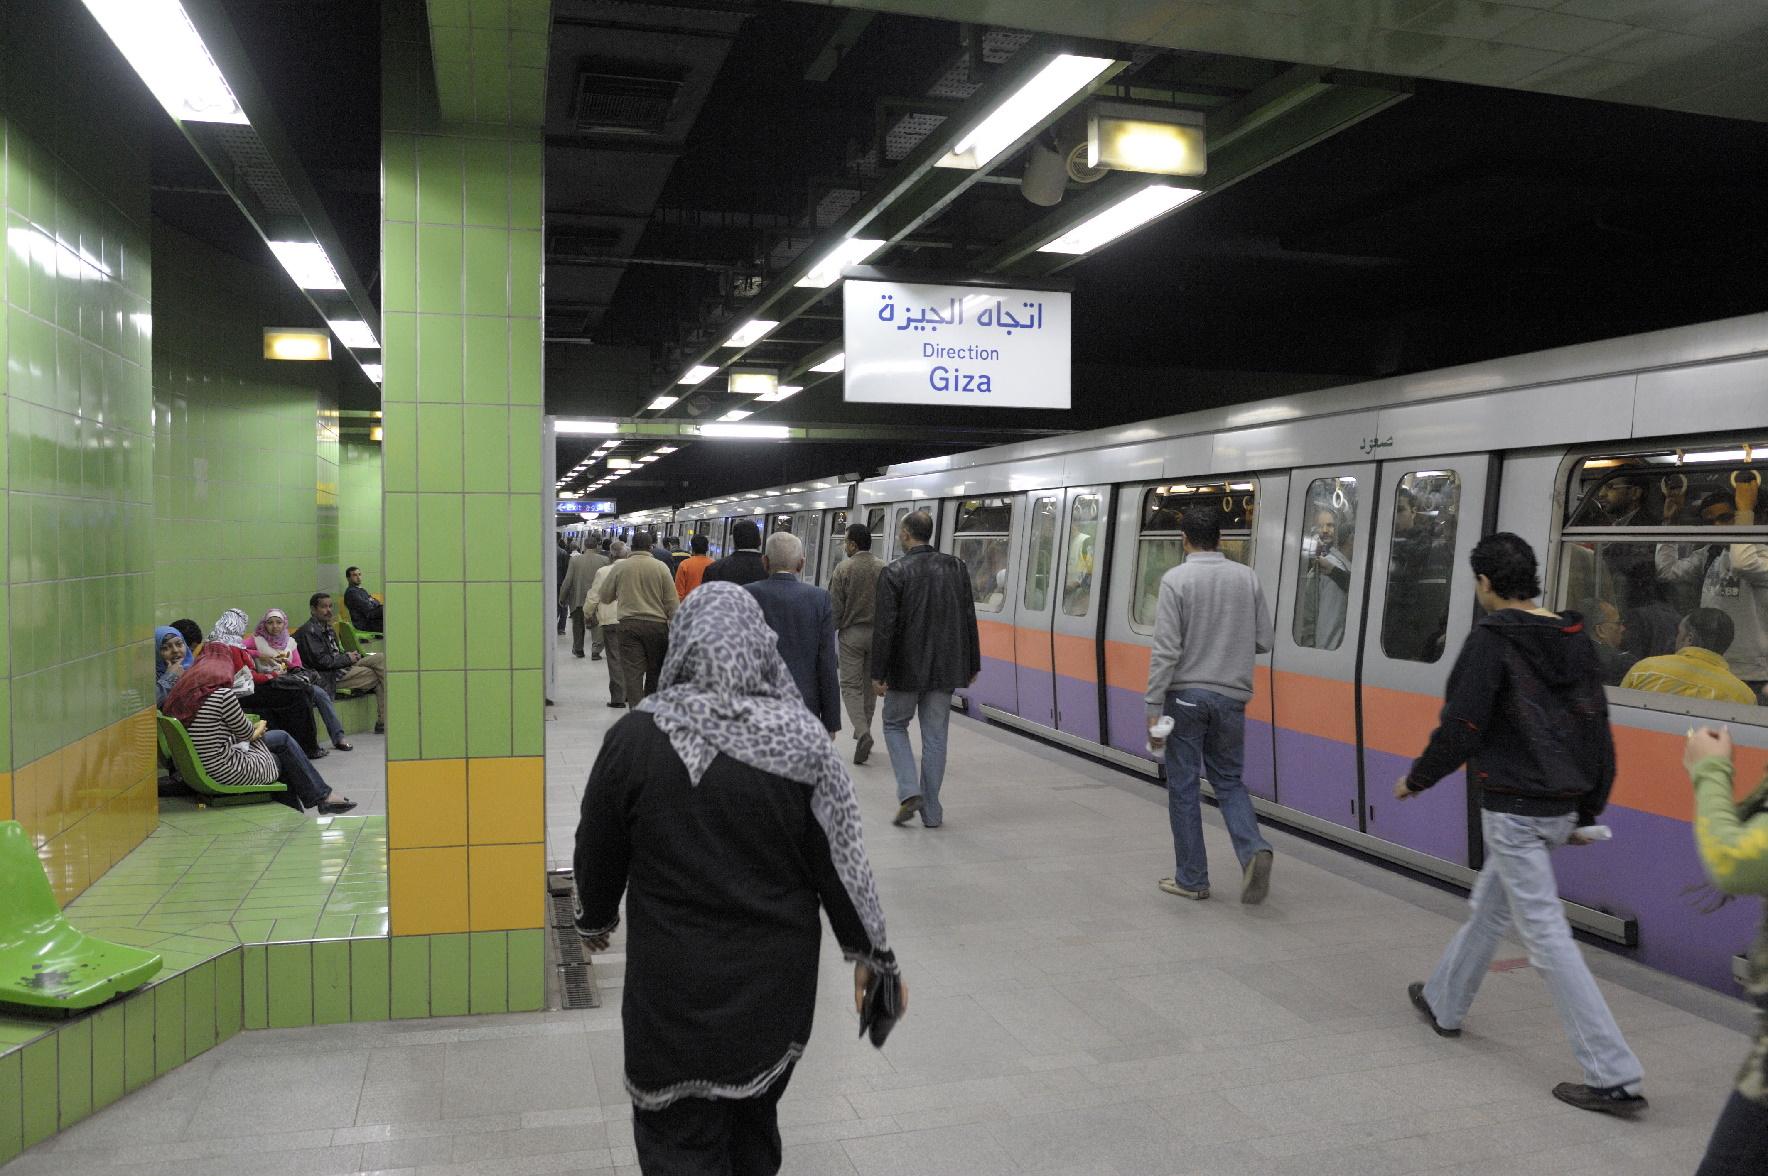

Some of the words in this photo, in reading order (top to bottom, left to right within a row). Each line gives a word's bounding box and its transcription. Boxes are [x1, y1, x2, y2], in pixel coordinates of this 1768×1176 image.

[878, 294, 964, 332] الجيزة
[976, 300, 1042, 336] اتجاه
[922, 342, 999, 361] Direction
[929, 365, 992, 393] Giza
